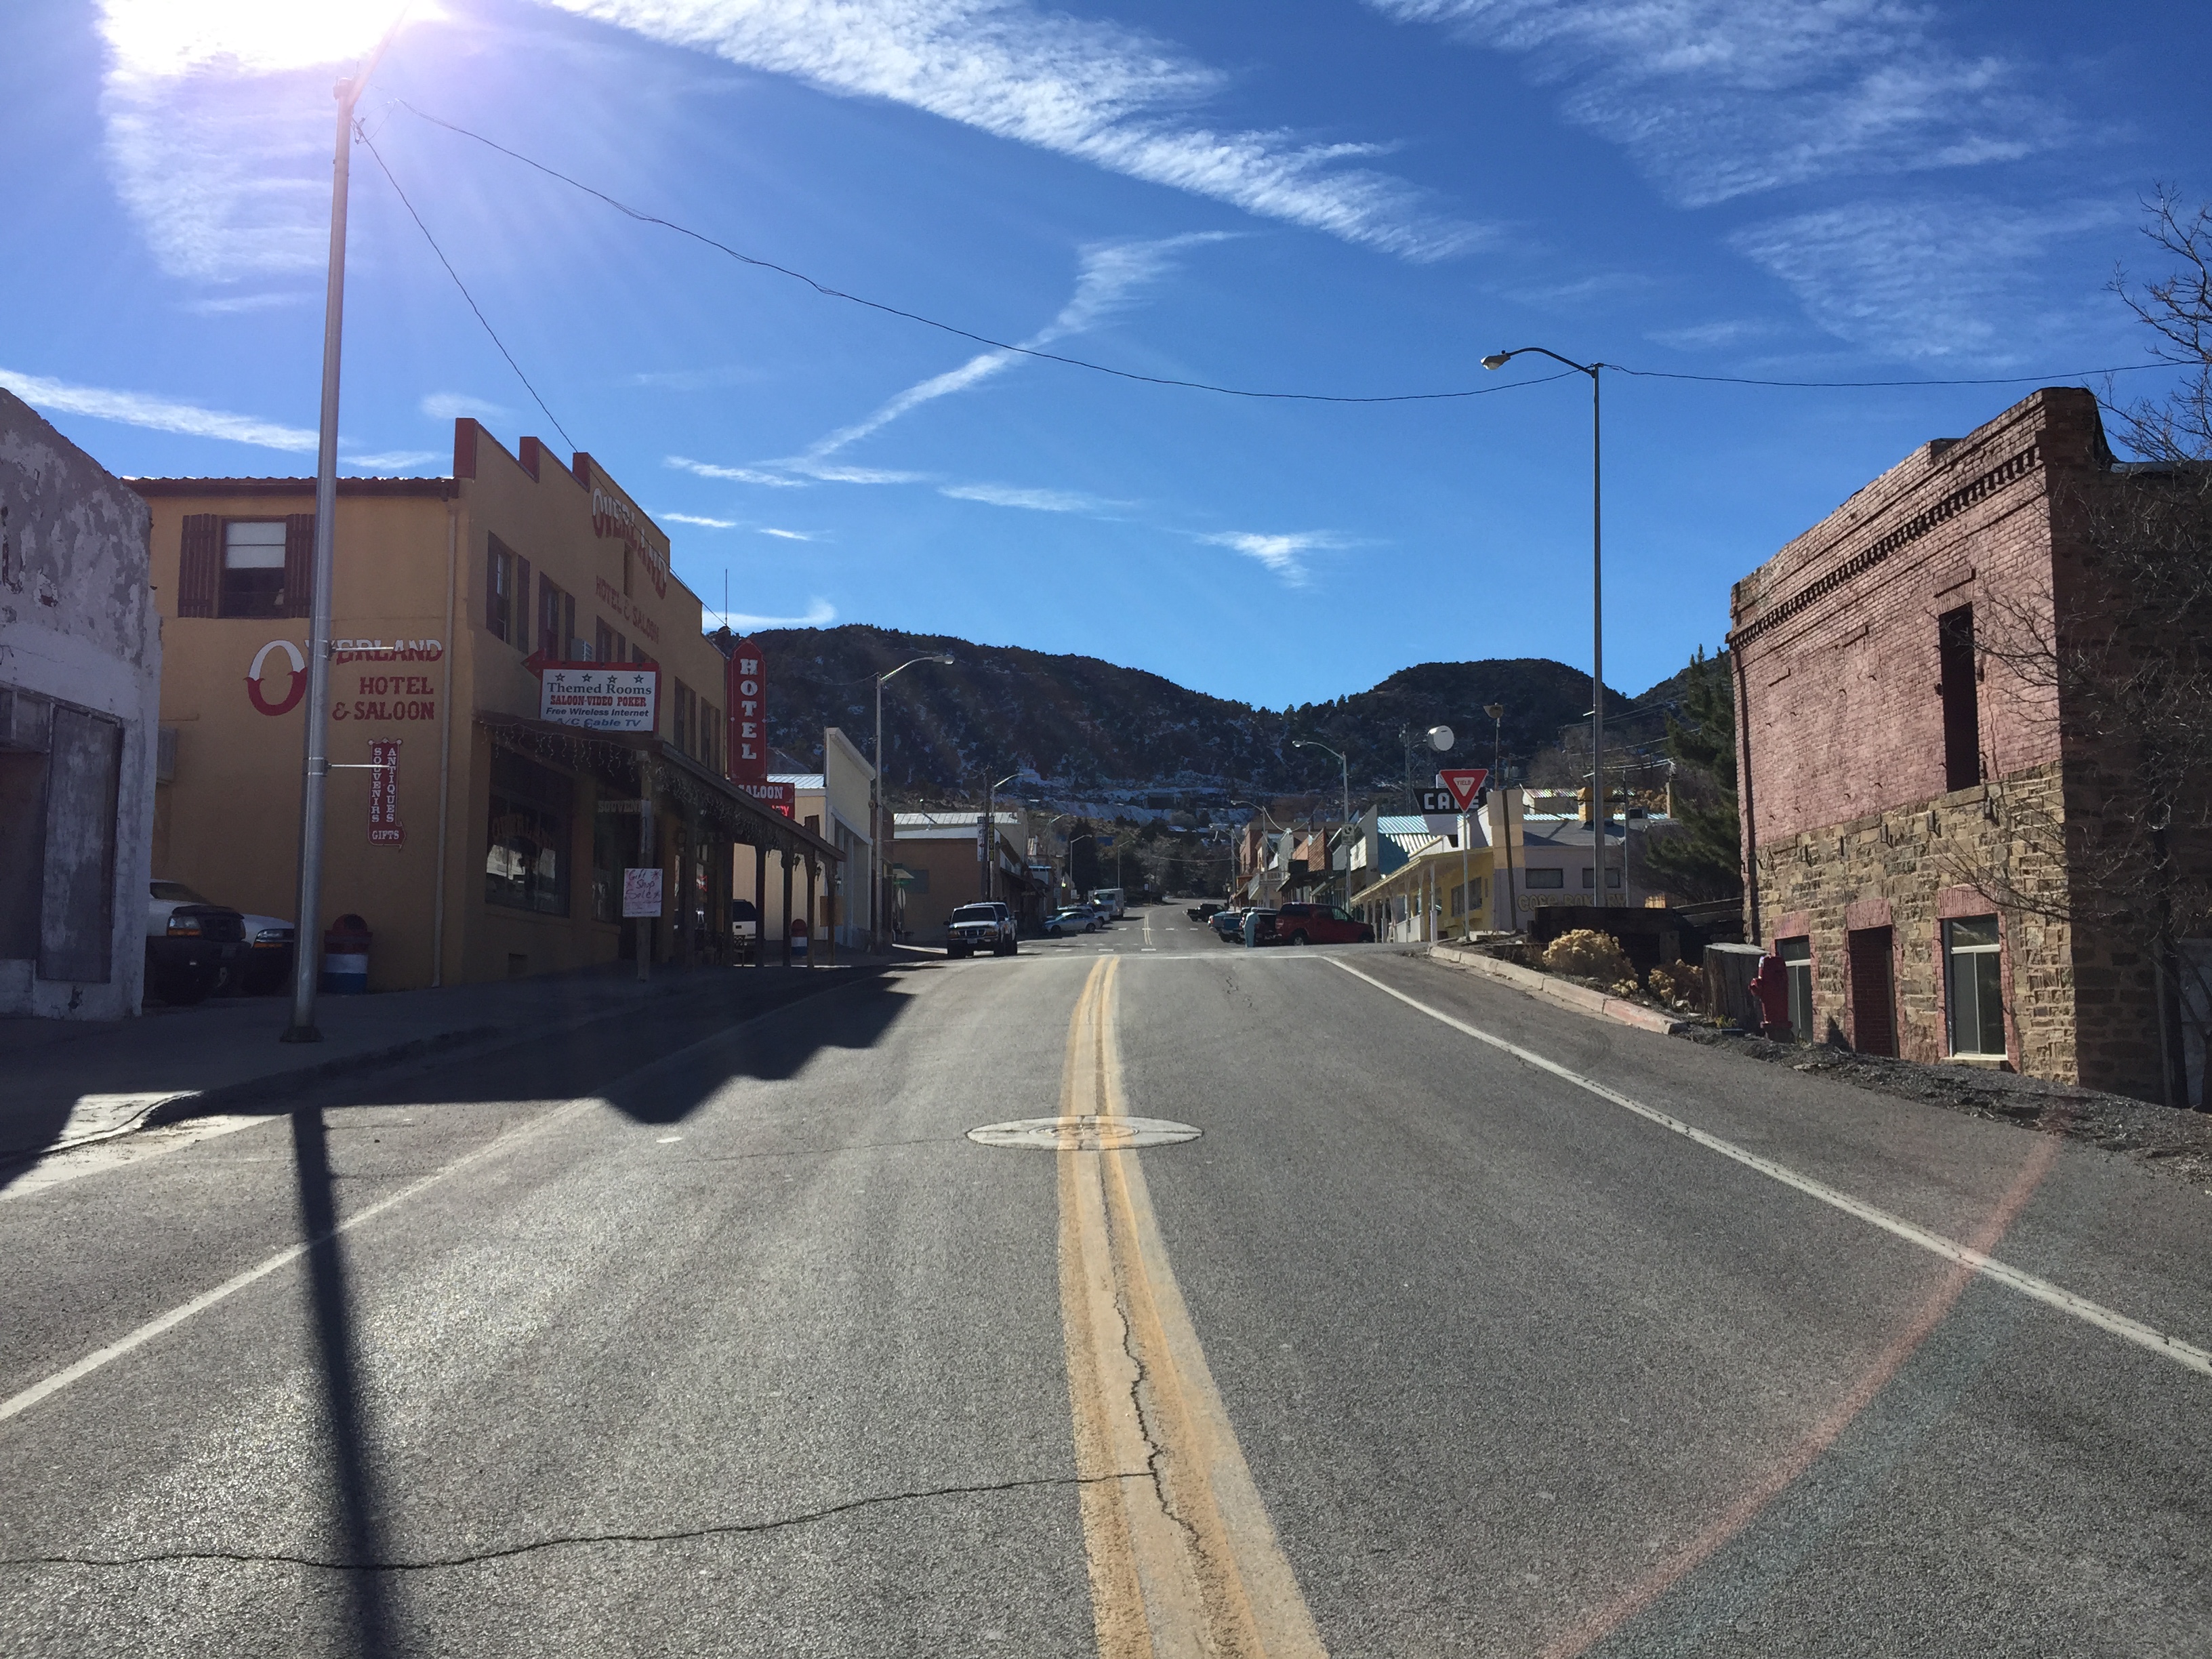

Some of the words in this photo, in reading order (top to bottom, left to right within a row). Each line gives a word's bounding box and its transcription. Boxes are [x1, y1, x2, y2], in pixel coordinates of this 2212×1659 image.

[592, 488, 667, 600] OVERLAND
[596, 575, 622, 614] HOTEL
[632, 606, 659, 644] SALOON
[243, 640, 443, 716] OERLAND
[360, 676, 434, 695] HOTEL
[547, 682, 601, 693] Themed
[606, 684, 652, 695] Rooms
[332, 702, 351, 720] &
[354, 701, 434, 720] SALOON
[550, 695, 613, 706] SALOON-VIDEO
[617, 697, 647, 707] POKER
[740, 658, 758, 760] HOTEL
[570, 708, 609, 716] Wireless
[611, 709, 649, 717] Internet
[584, 718, 621, 727] Cable
[386, 747, 396, 822] ANTIQUES
[1424, 792, 1479, 810] CAE
[372, 830, 399, 840] GIFTS
